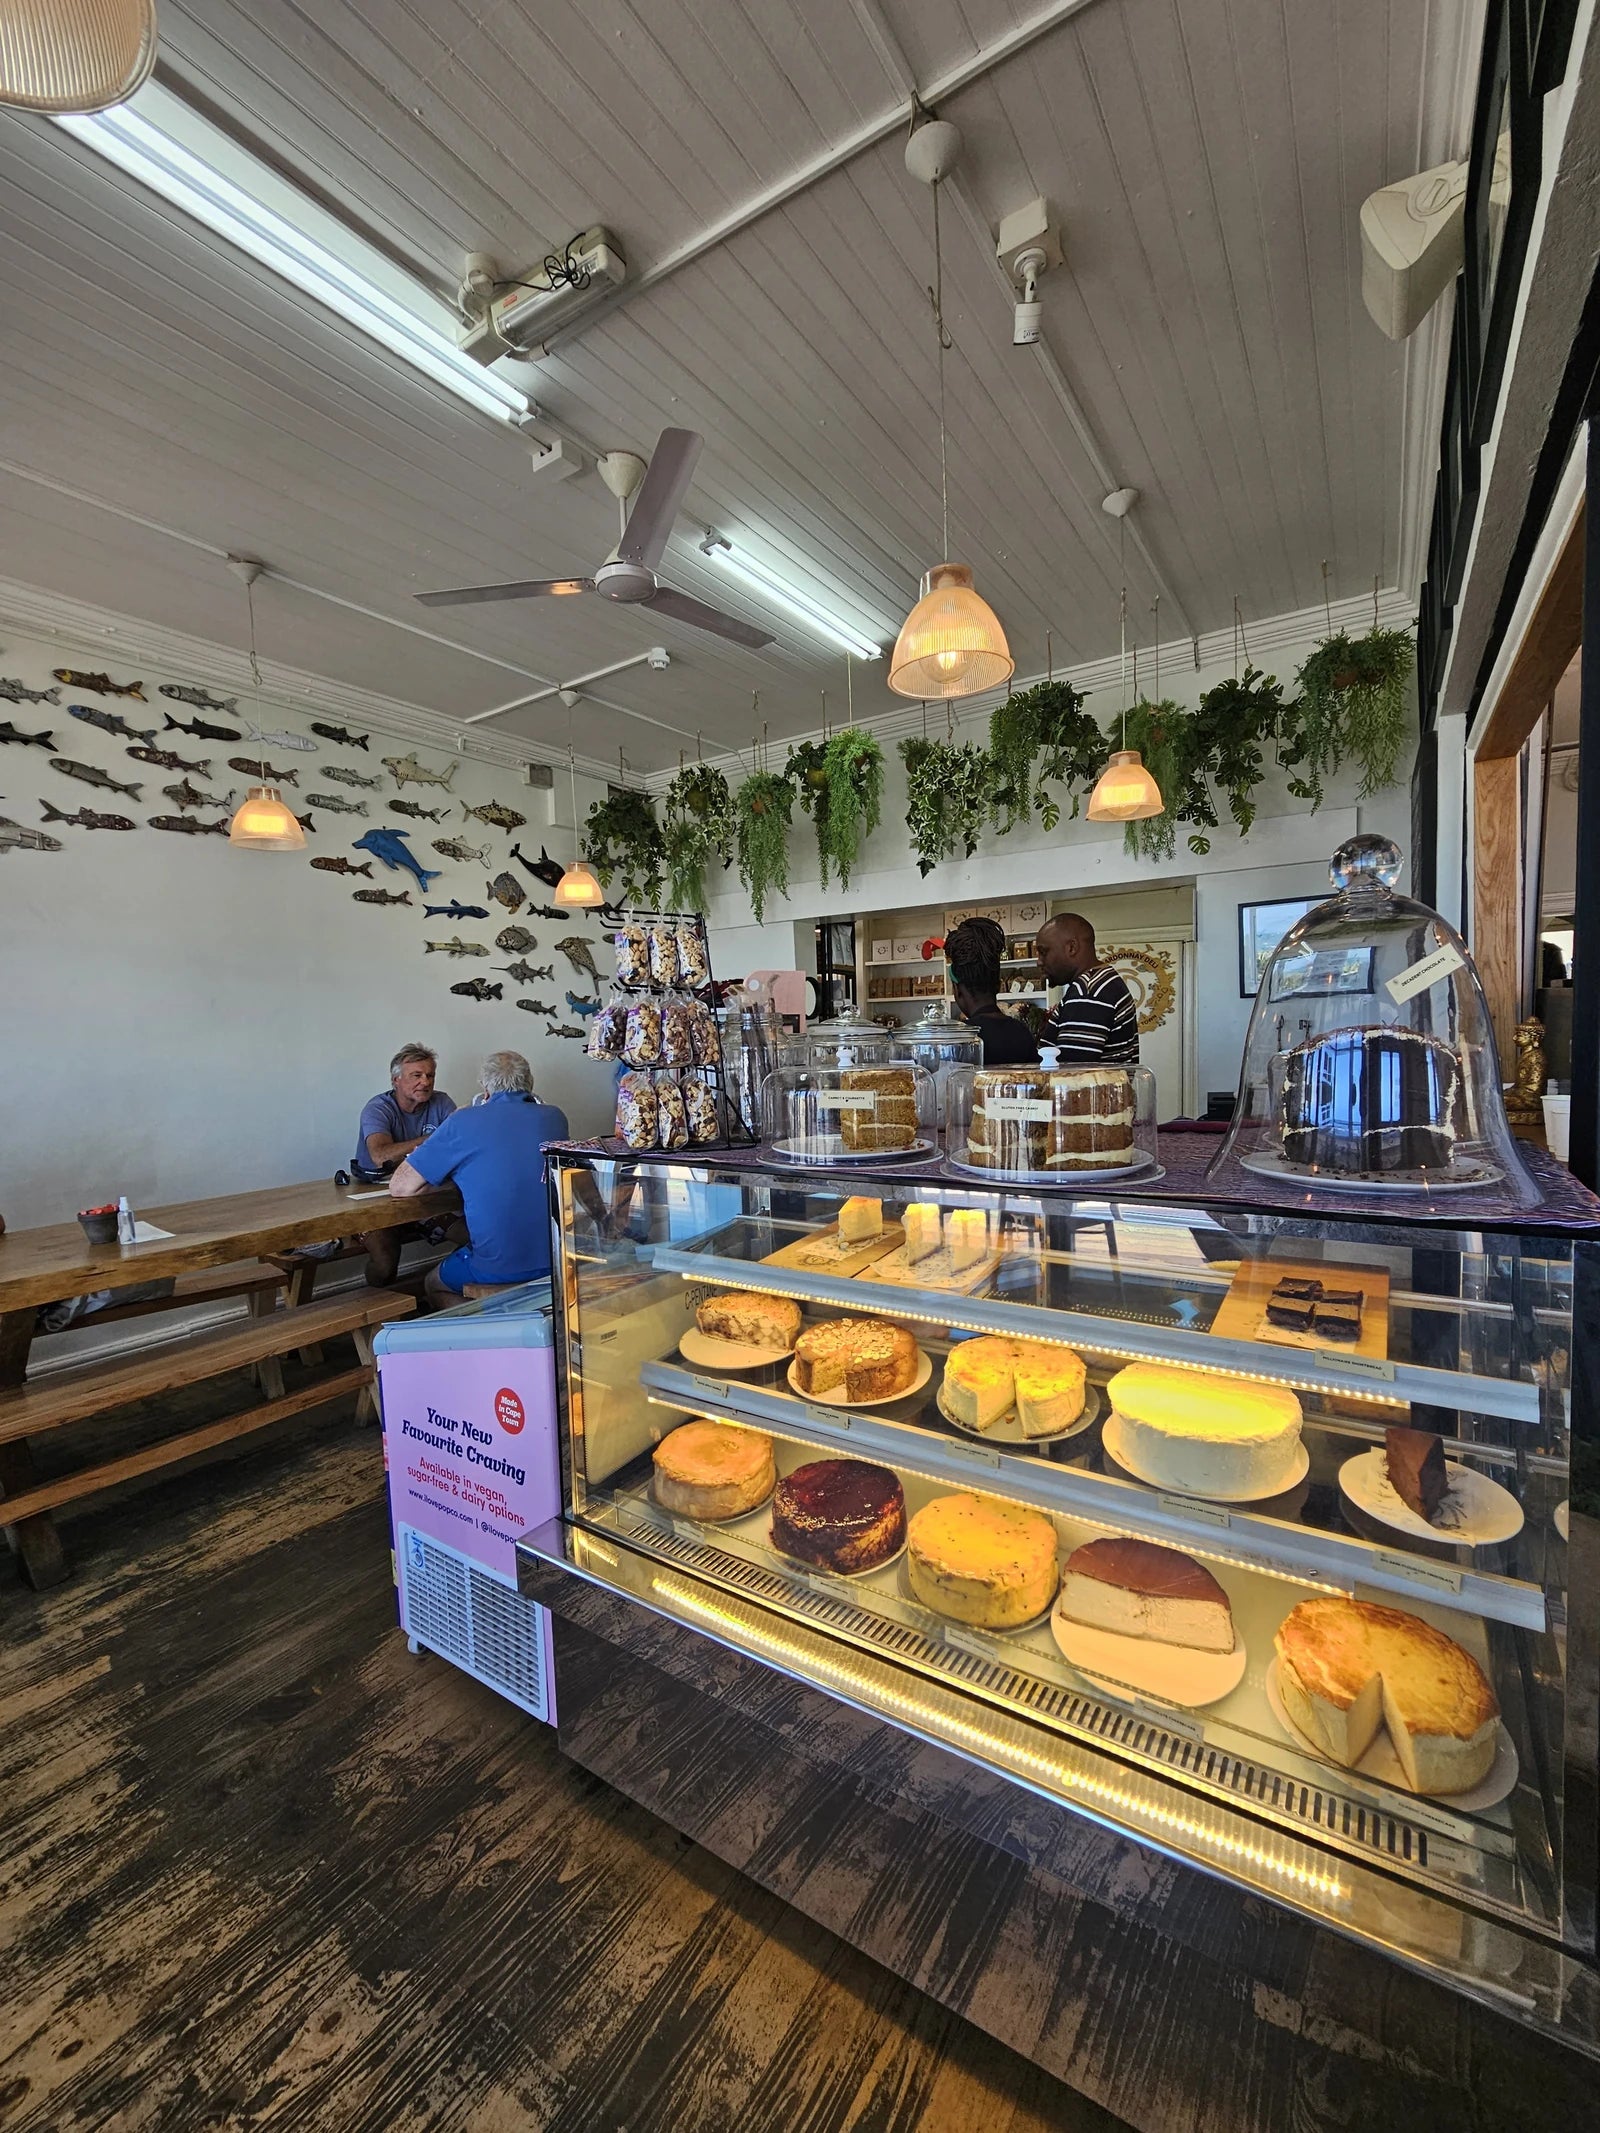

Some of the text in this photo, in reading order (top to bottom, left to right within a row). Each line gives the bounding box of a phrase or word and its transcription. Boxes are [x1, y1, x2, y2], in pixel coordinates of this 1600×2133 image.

[1105, 952, 1159, 969] ARDONNAY DELI
[1401, 956, 1446, 987] DECADENT CHOCOLATE
[498, 1404, 522, 1419] in Cape
[501, 1396, 518, 1409] Made
[427, 1407, 493, 1446] Your New
[501, 1414, 519, 1428] Town
[402, 1419, 526, 1485] Favourite Craving
[407, 1466, 526, 1527] sugar-free & dairy options
[419, 1456, 507, 1505] Available in vegan,
[408, 1489, 474, 1524] www.ilovepopco.com
